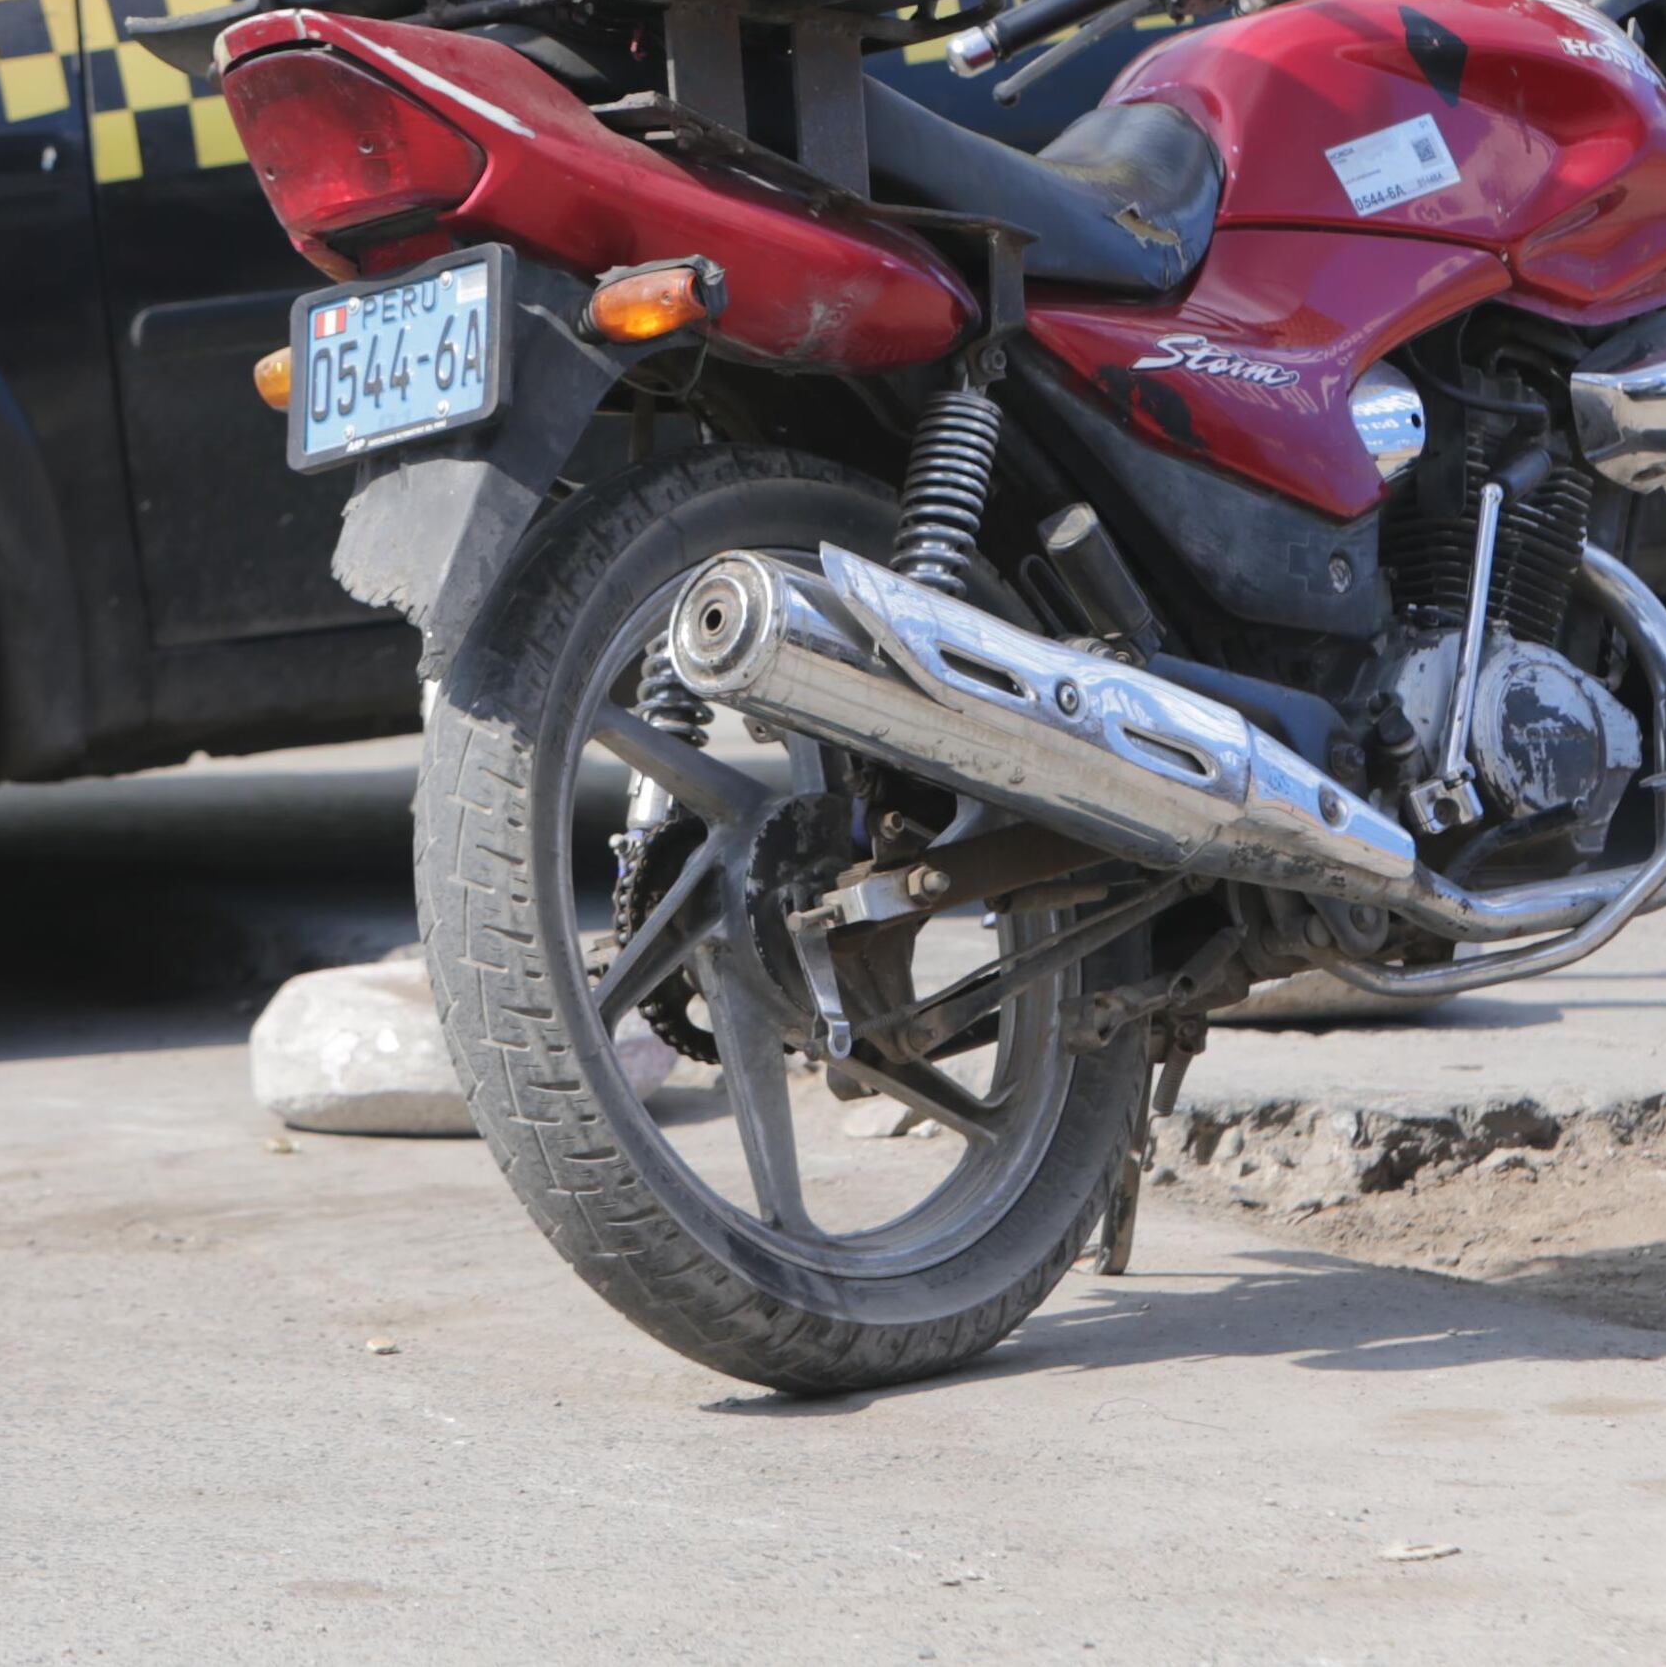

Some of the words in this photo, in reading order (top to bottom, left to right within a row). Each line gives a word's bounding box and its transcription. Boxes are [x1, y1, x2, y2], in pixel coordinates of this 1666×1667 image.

[1354, 184, 1408, 211] 0544-6A
[362, 283, 437, 330] PERU
[310, 308, 483, 423] 0544-6A
[1129, 333, 1300, 388] Storm
